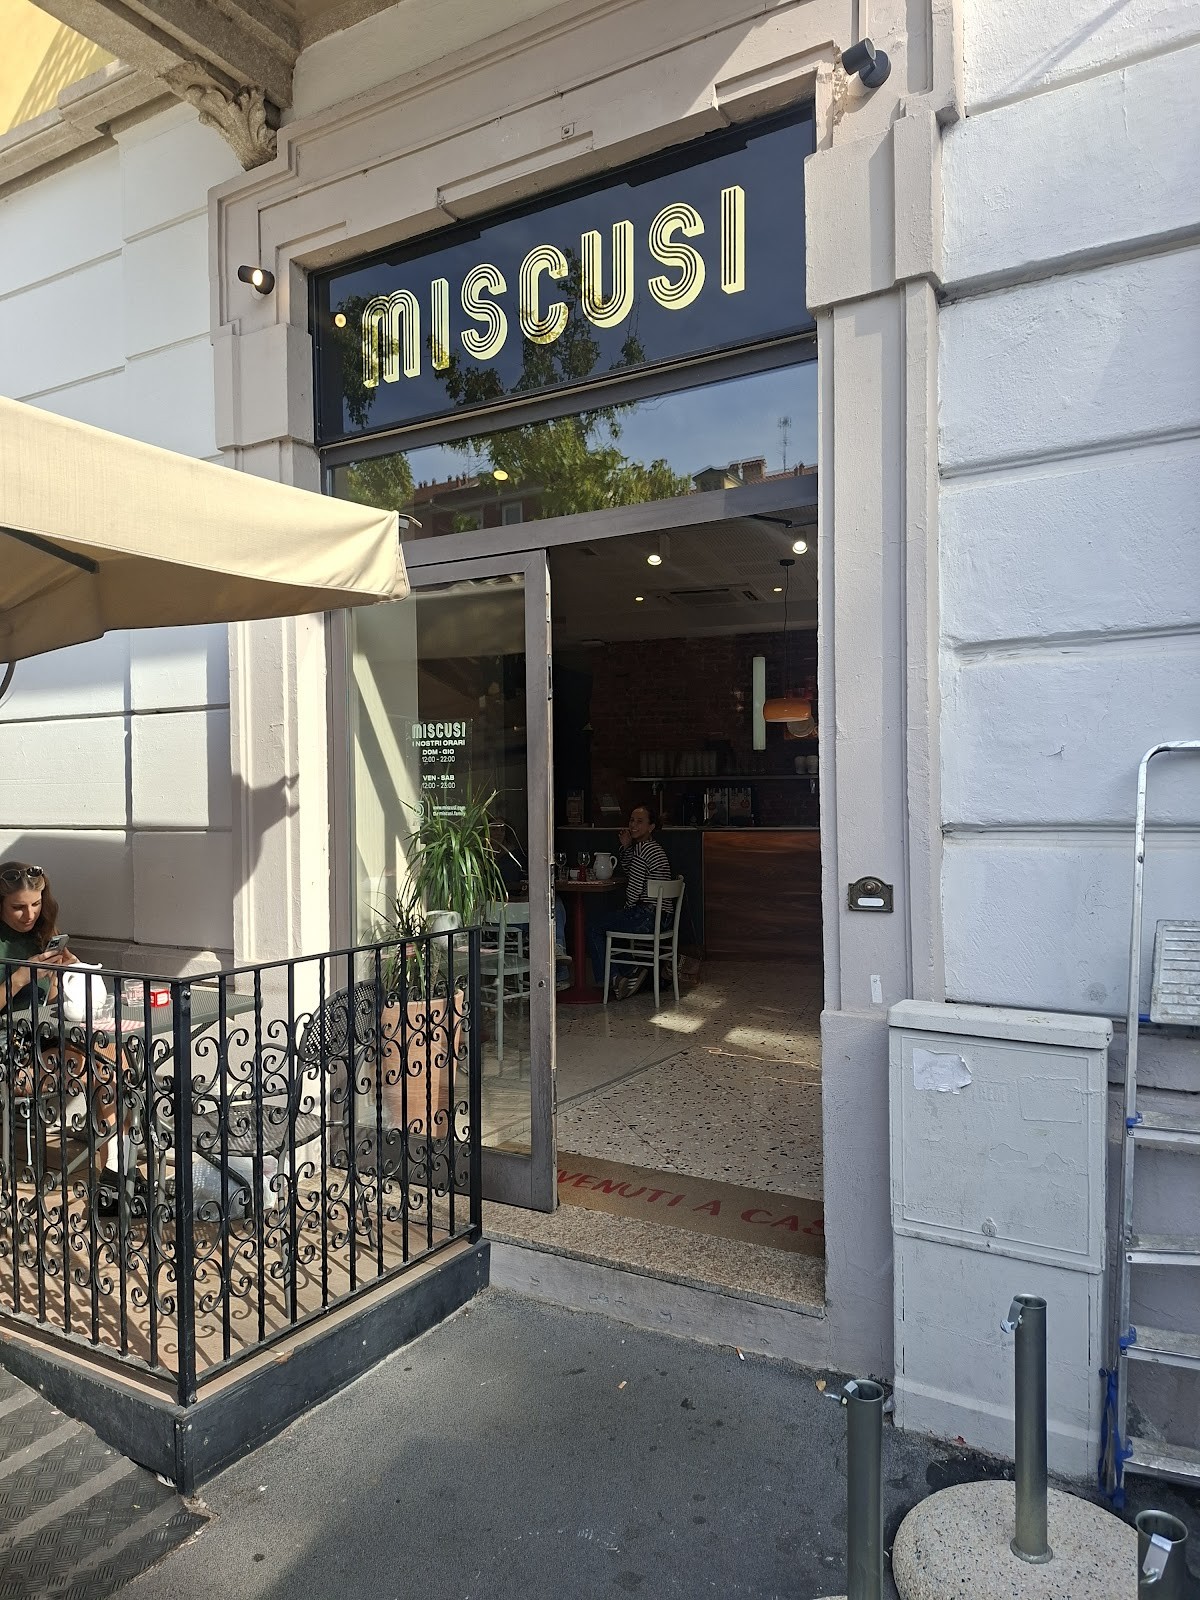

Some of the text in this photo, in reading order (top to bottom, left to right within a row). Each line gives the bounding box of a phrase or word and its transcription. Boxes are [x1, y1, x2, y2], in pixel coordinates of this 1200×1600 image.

[362, 185, 746, 388] MISCUSI
[412, 722, 466, 738] MISCUSI
[557, 1169, 686, 1206] VENUTI
[692, 1200, 721, 1216] A
